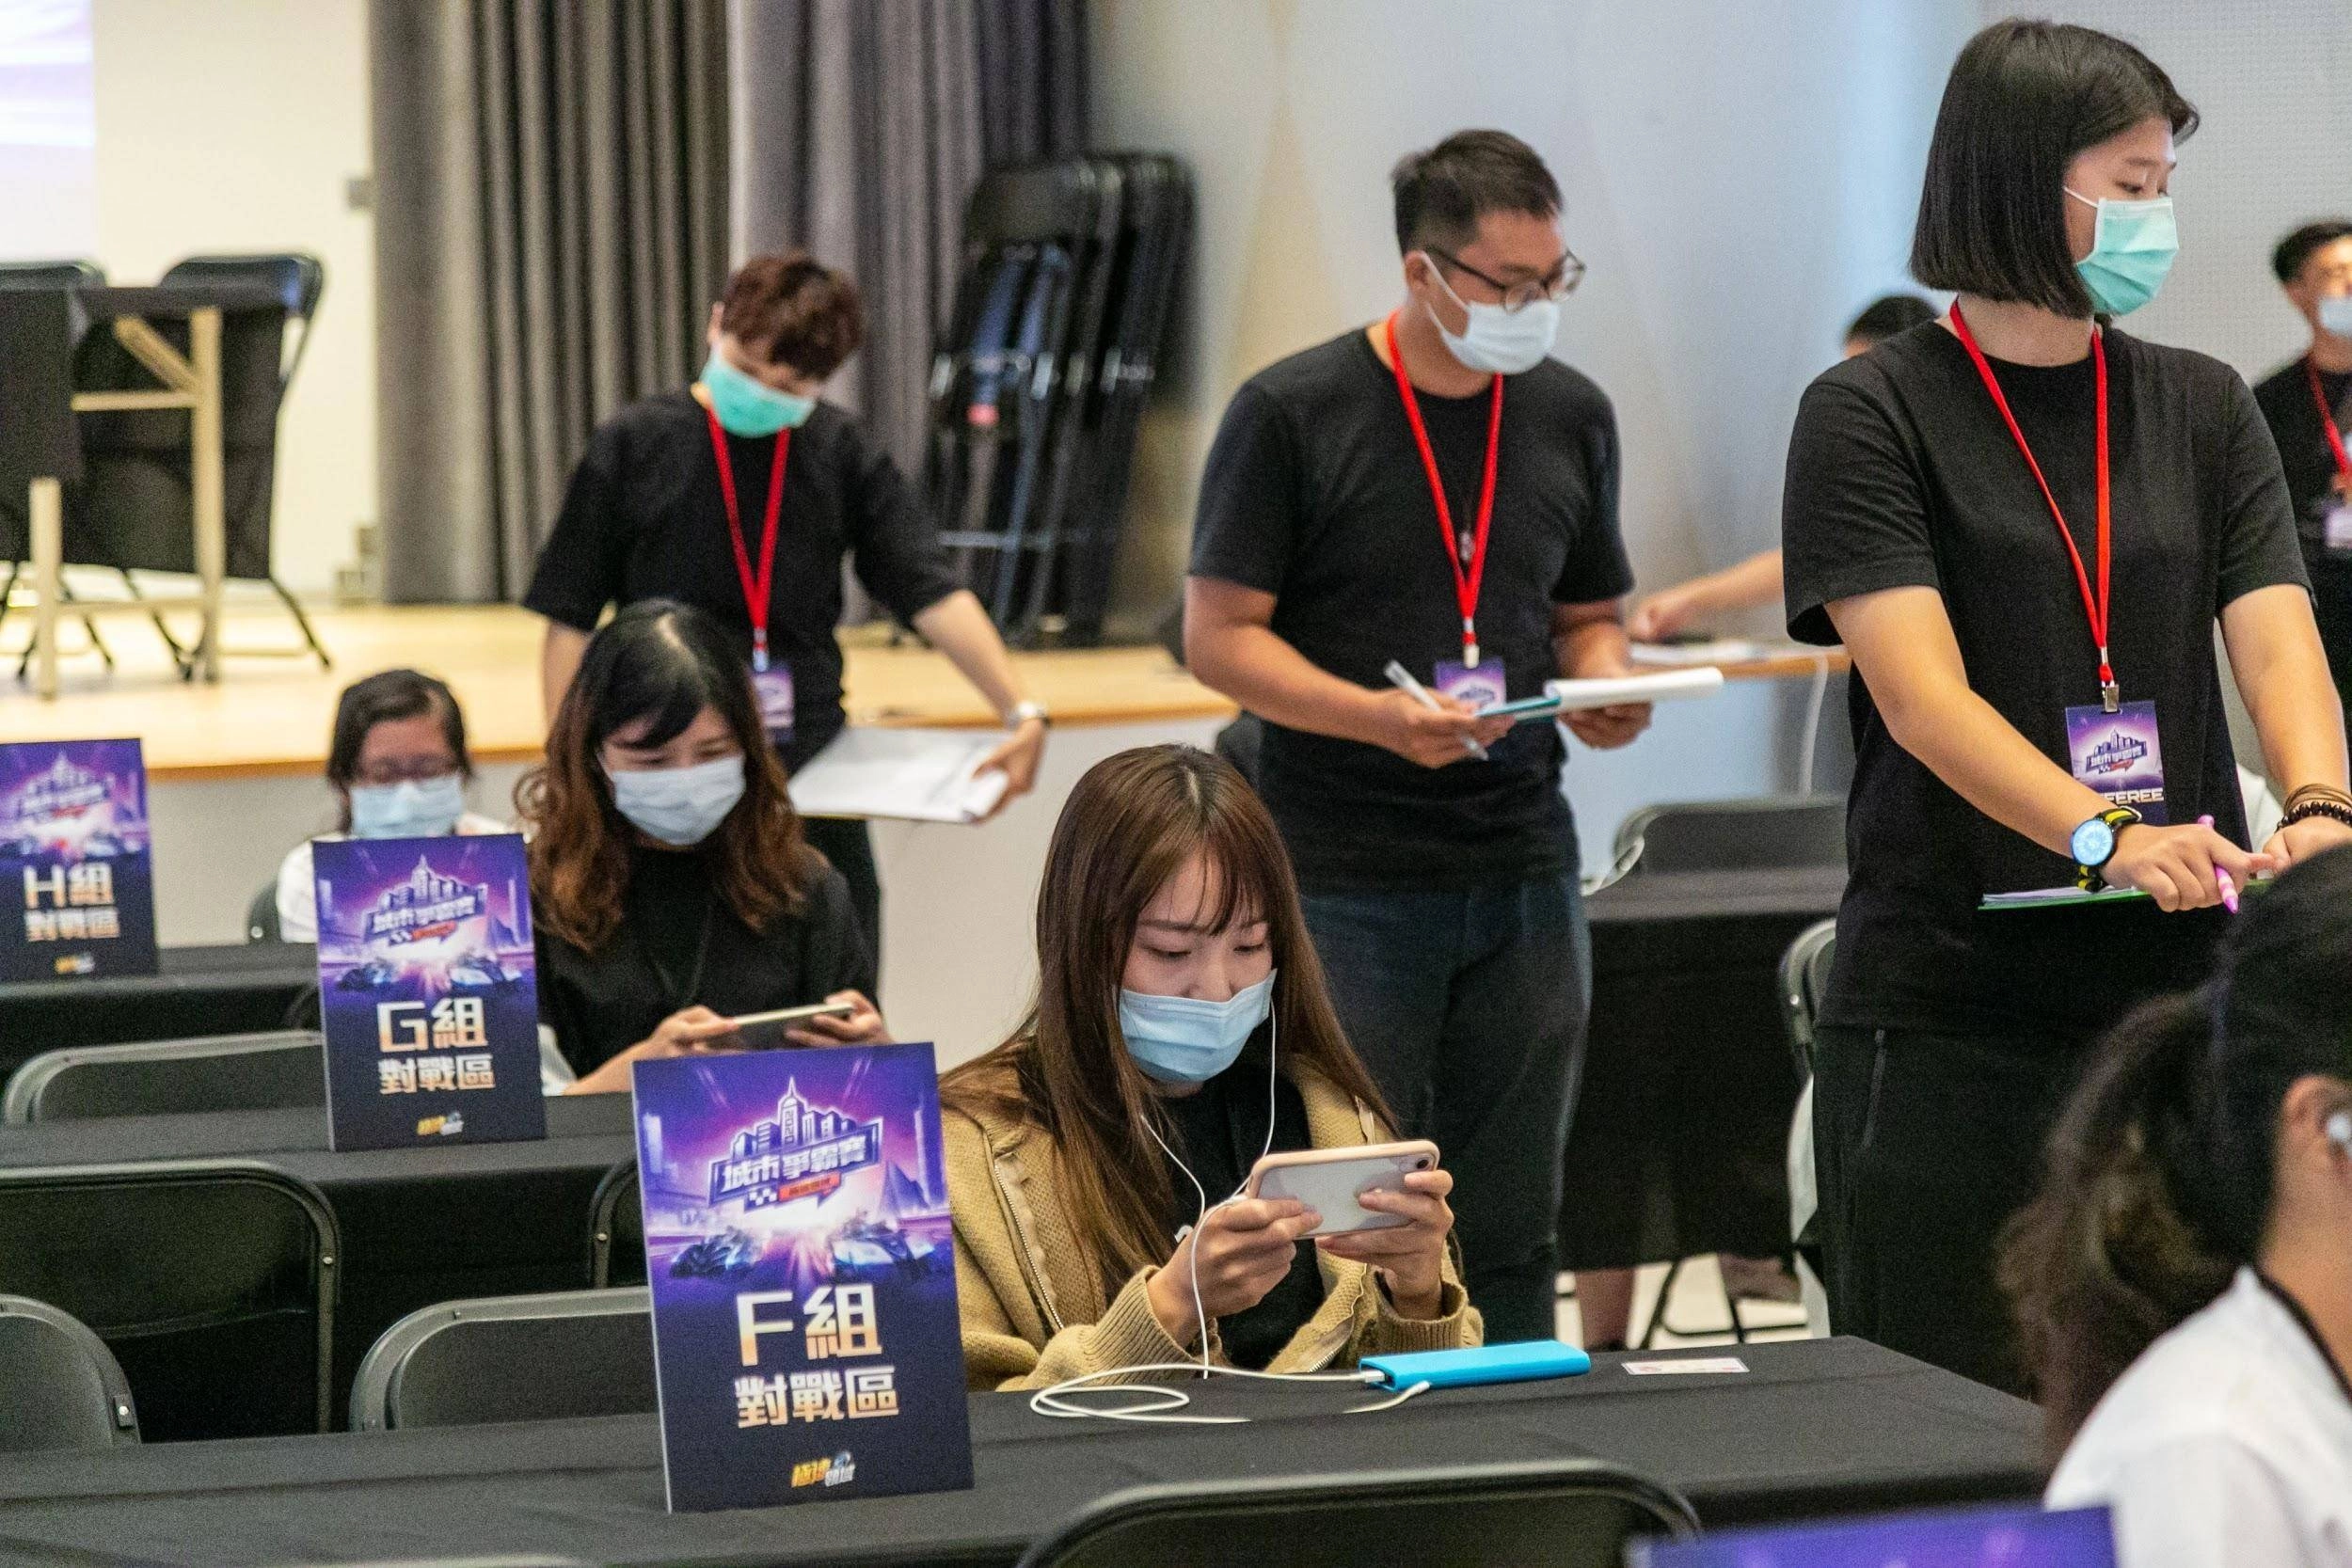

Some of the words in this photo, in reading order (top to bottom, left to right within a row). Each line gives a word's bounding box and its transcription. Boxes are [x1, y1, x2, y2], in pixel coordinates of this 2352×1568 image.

[2102, 788, 2164, 804] FEREE
[377, 997, 488, 1052] G組
[378, 1054, 495, 1093] 對戰區
[722, 1136, 866, 1193] 城市爭霸賽
[737, 1285, 882, 1366] F組
[734, 1366, 898, 1428] 對戰區
